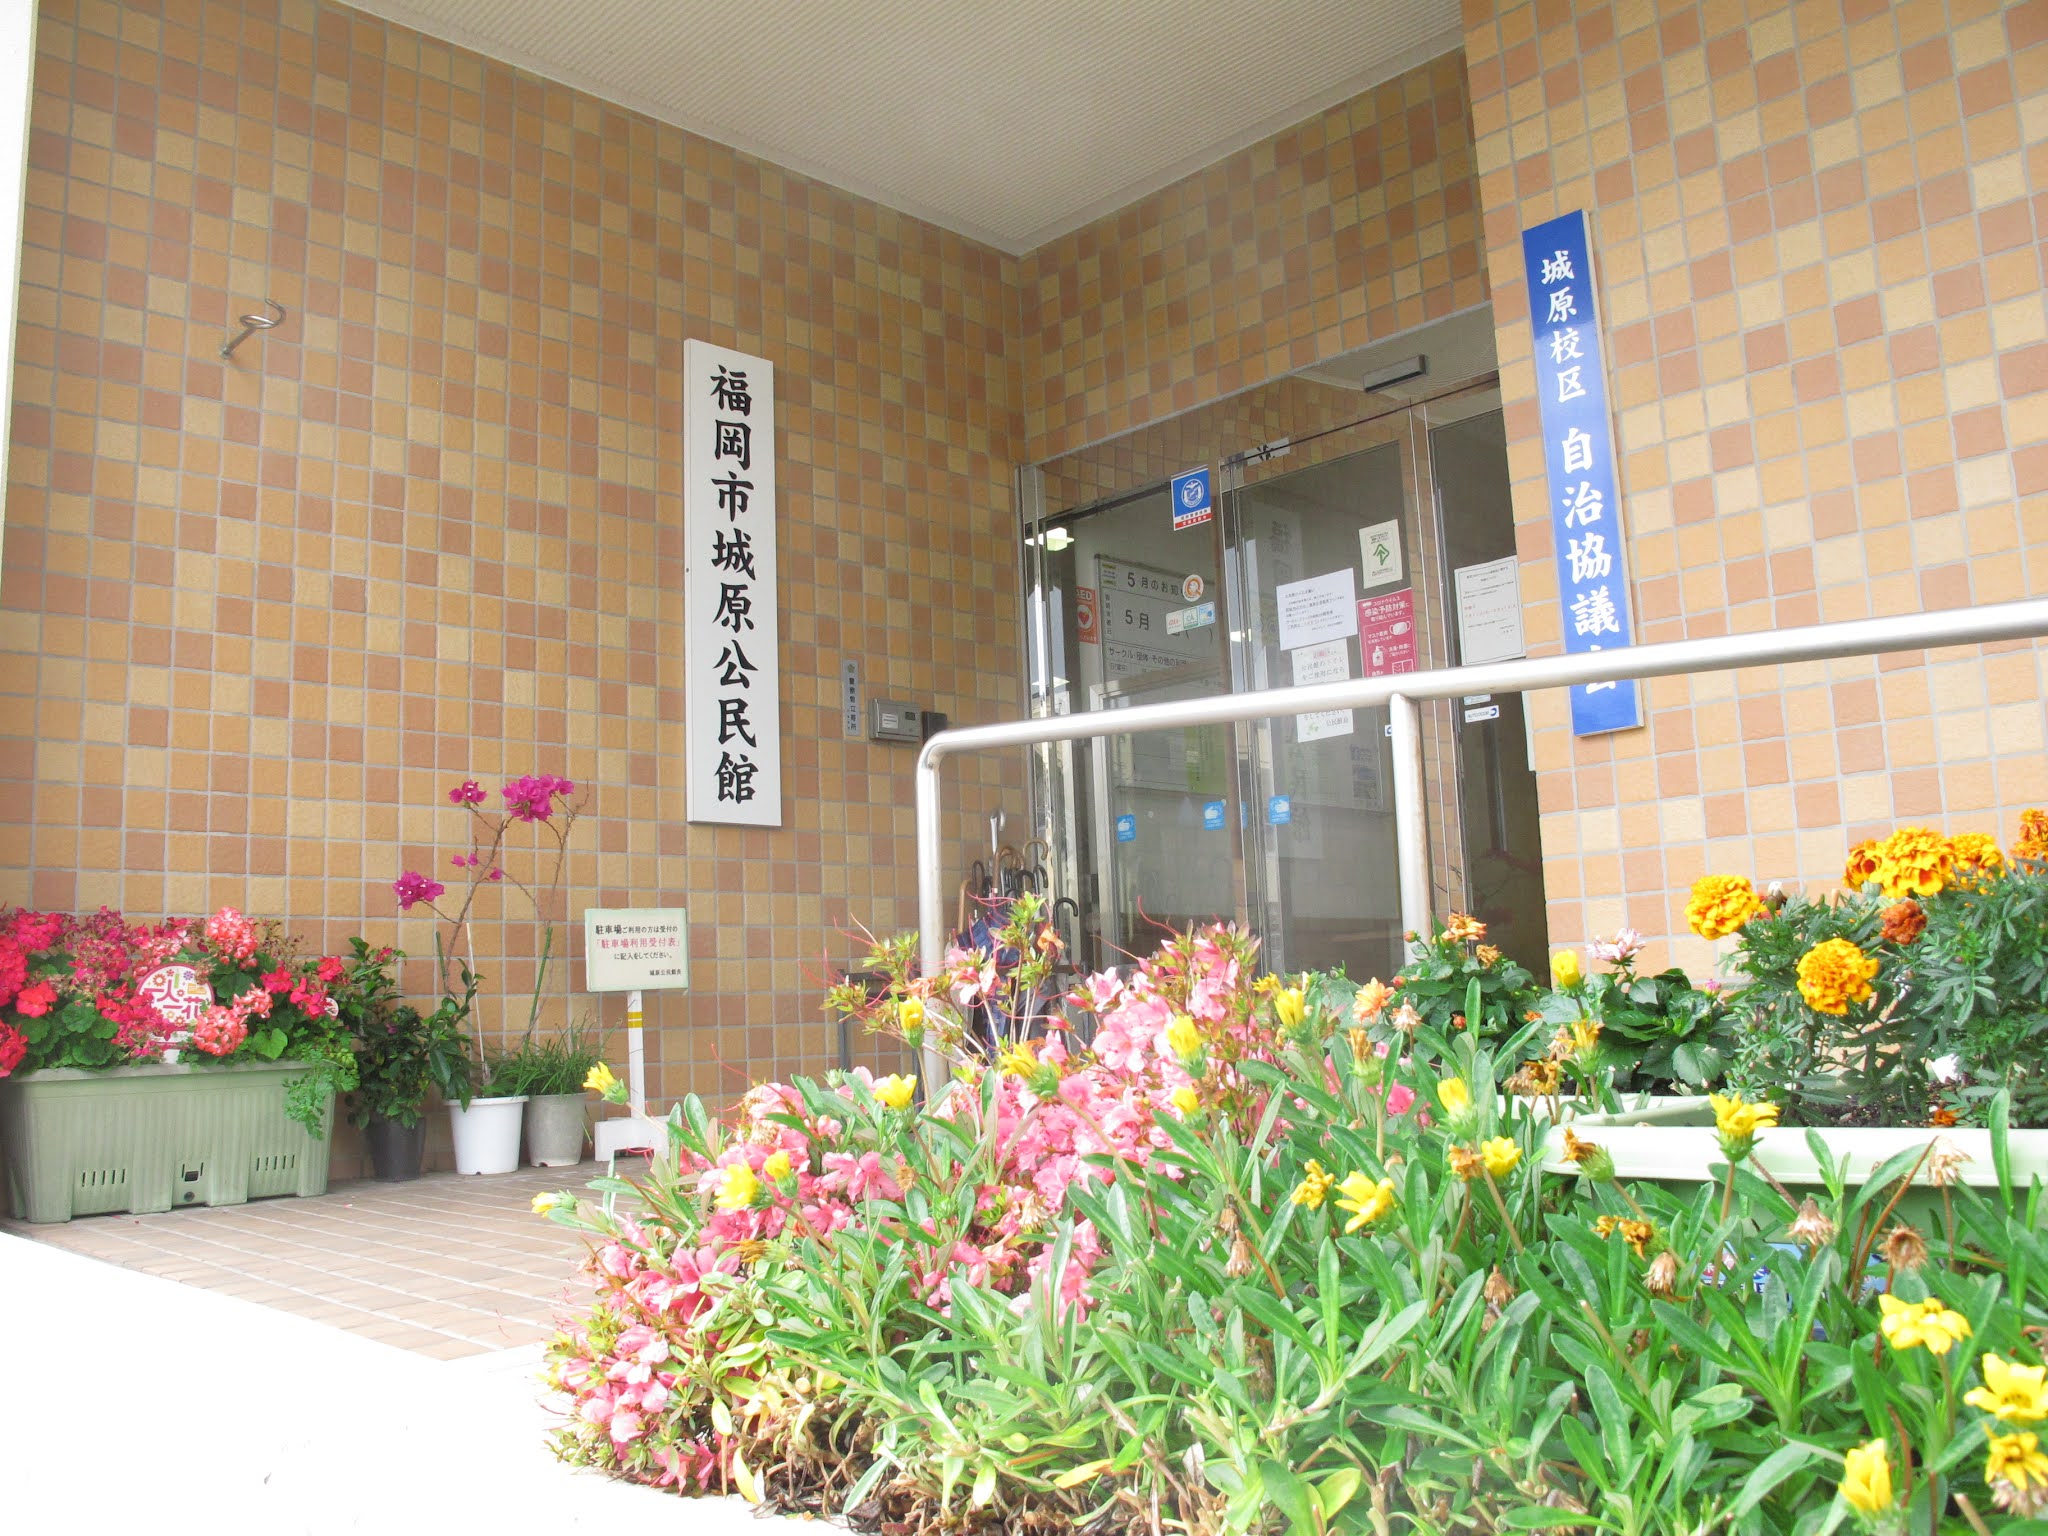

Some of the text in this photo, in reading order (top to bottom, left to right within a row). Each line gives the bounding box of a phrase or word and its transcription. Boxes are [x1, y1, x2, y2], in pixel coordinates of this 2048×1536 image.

[1540, 249, 1587, 404] 城原校区
[709, 363, 760, 805] 福岡市城原公民館
[595, 924, 678, 935] 駐車場ご利用の方は受付の
